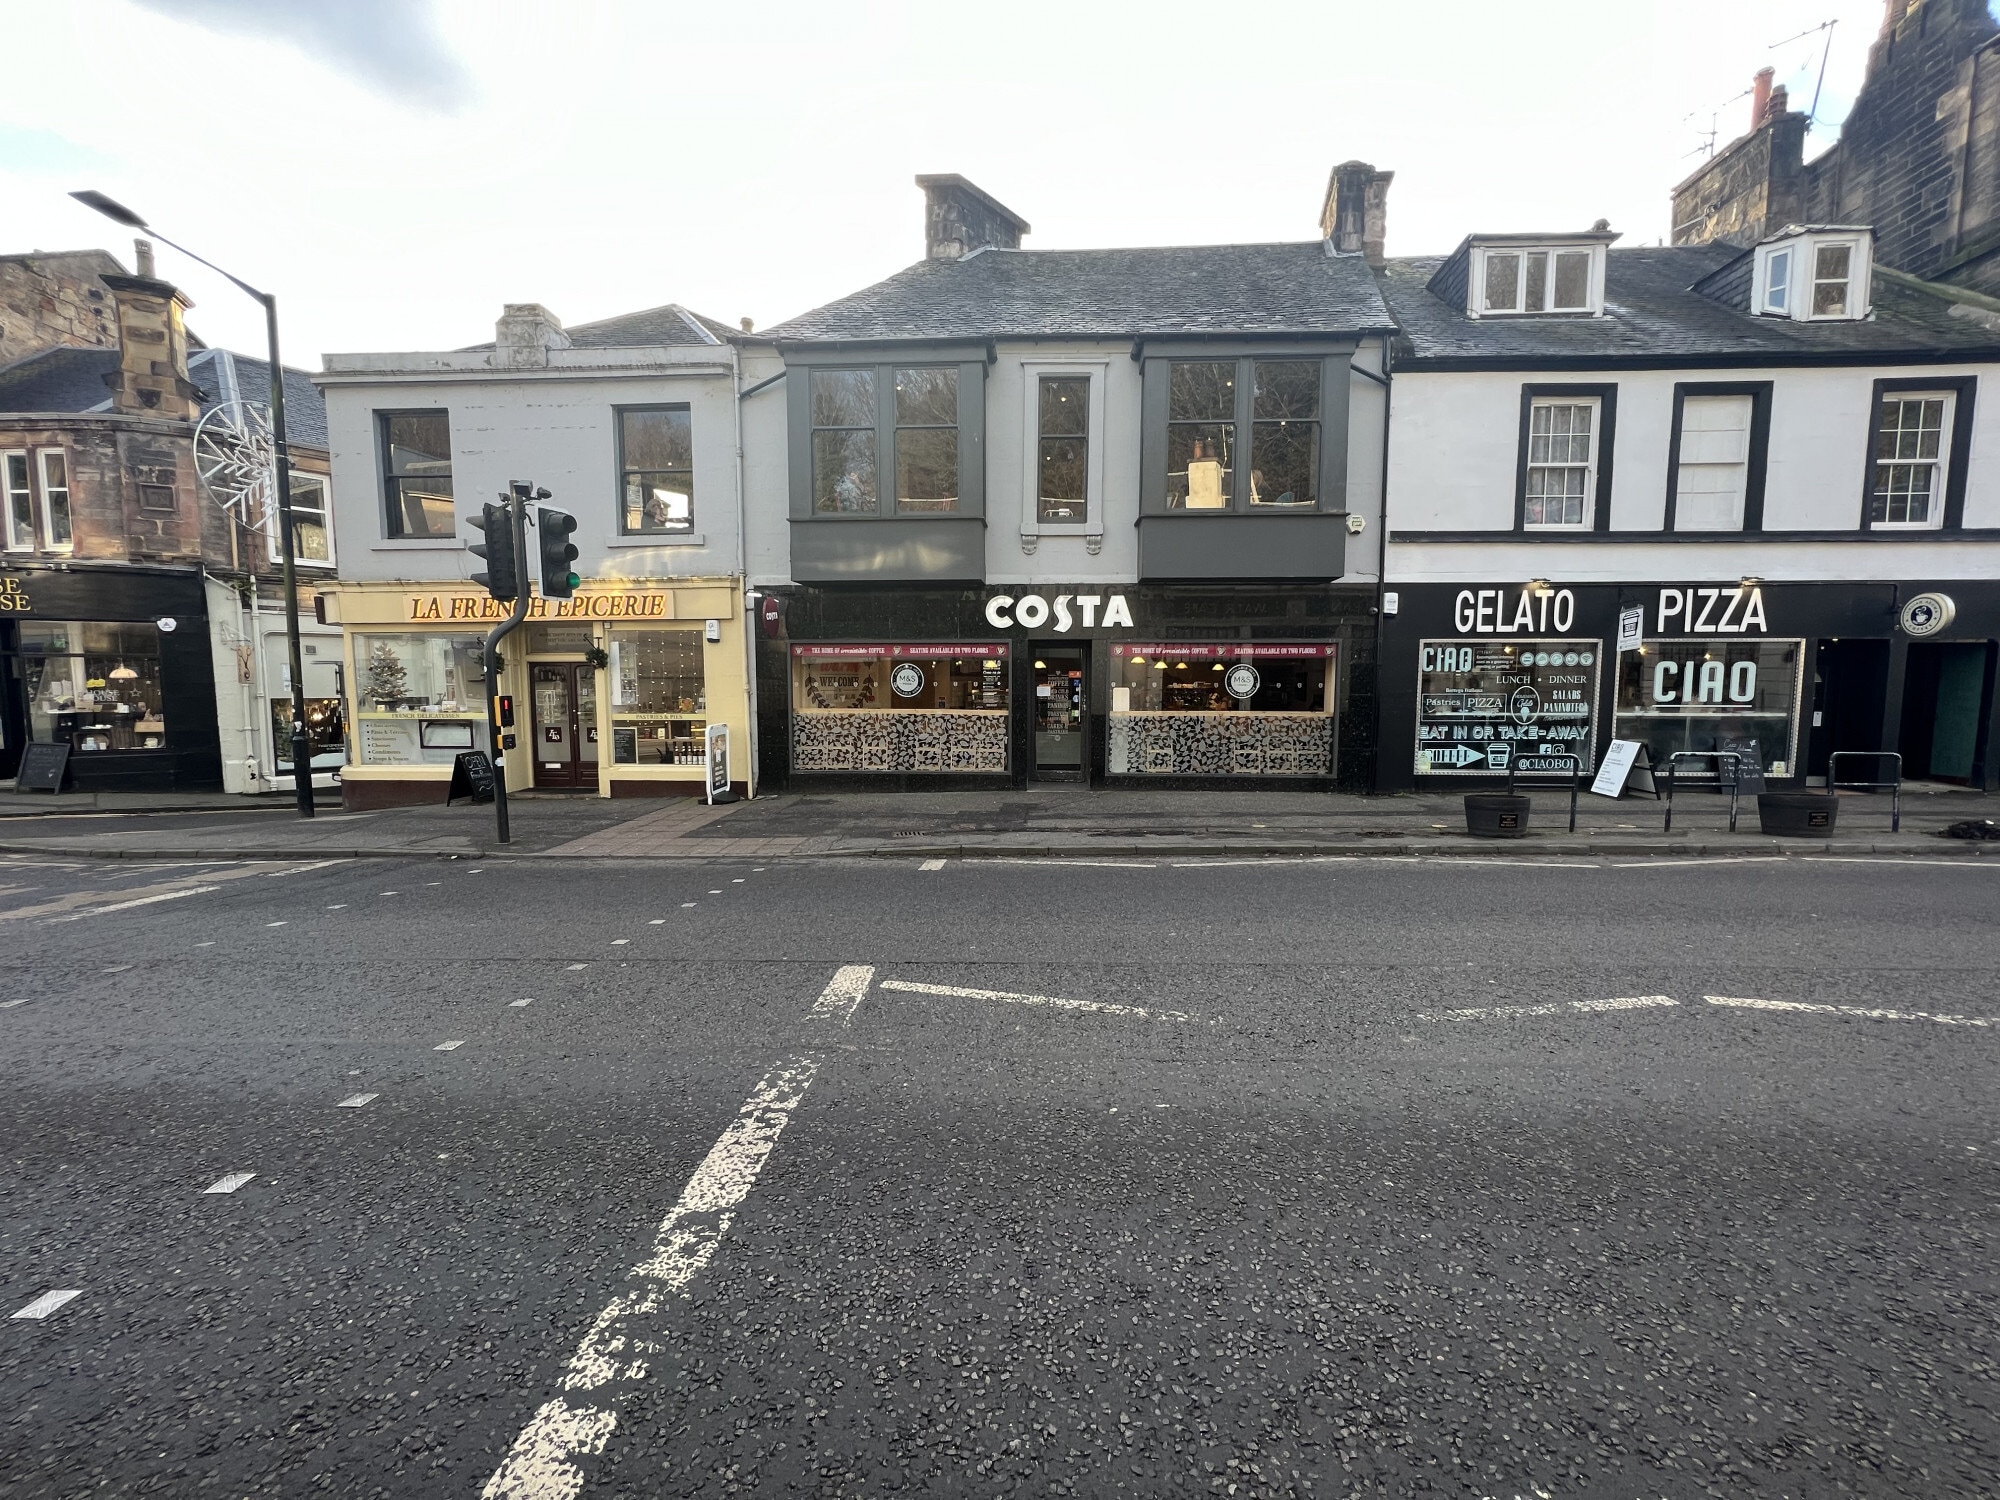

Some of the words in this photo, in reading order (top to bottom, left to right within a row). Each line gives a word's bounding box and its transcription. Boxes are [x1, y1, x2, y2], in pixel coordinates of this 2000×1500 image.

[411, 597, 442, 619] LA
[449, 595, 549, 619] FRENH
[554, 594, 665, 618] EPICERIE
[766, 611, 778, 621] COSTA
[985, 594, 1134, 633] COSTA
[1454, 588, 1574, 633] GELATO
[1657, 587, 1767, 633] PIZZA
[1422, 647, 1472, 672] CIAO
[899, 675, 916, 683] M&S
[1496, 675, 1531, 684] LUNCH
[1549, 675, 1587, 684] DINNER
[1653, 660, 1757, 703] CIAO
[1467, 697, 1503, 708] PIZZA
[1552, 690, 1582, 700] SALADS
[1419, 725, 1449, 740] EAT
[1452, 725, 1468, 740] IN
[1472, 725, 1495, 740] OR
[1497, 725, 1589, 740] TAKE-AWAY
